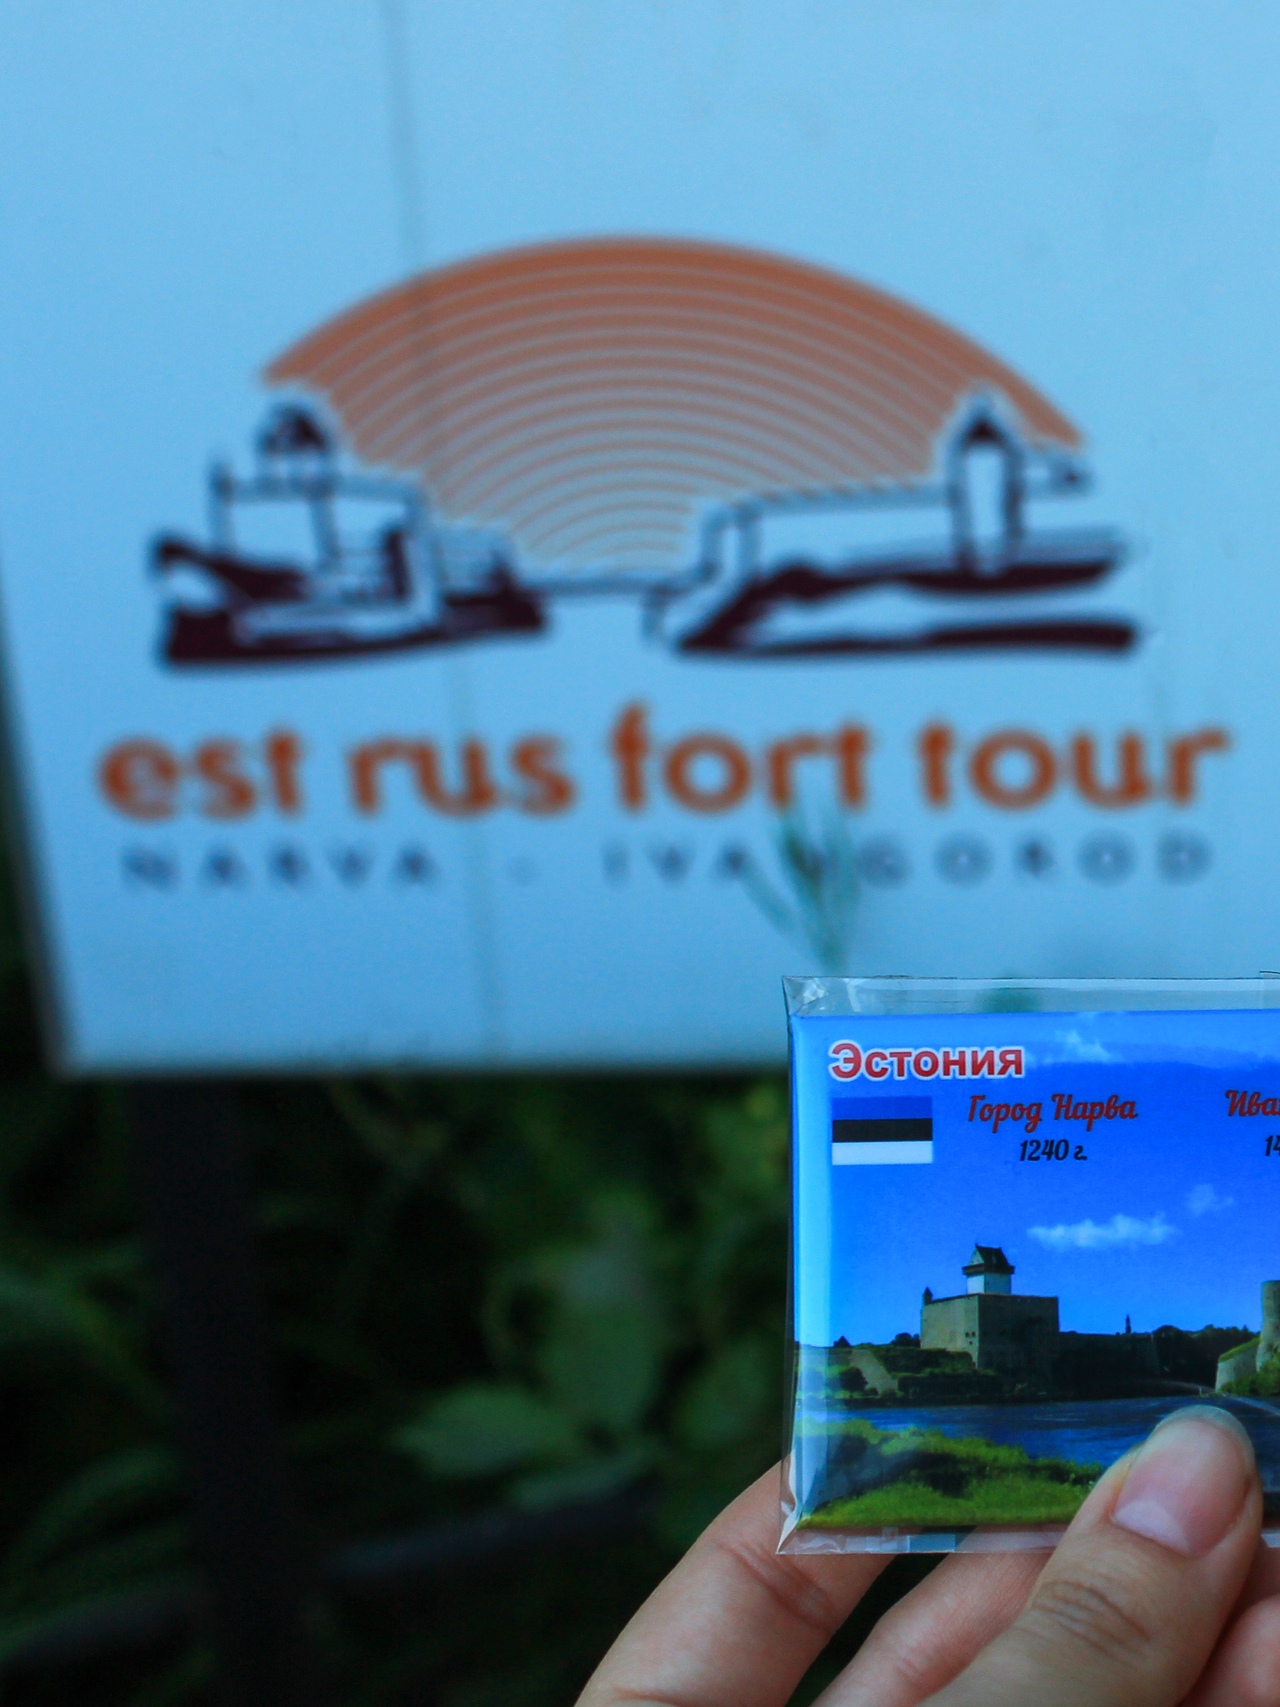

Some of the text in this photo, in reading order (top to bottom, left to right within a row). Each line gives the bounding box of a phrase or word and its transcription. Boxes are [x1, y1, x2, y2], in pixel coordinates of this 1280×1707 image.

[98, 700, 1231, 820] est rus fort tour
[122, 843, 438, 889] NARVA
[829, 1040, 1024, 1081] Эстония
[967, 1094, 1138, 1133] Город Нарва
[1019, 1139, 1070, 1162] 1240
